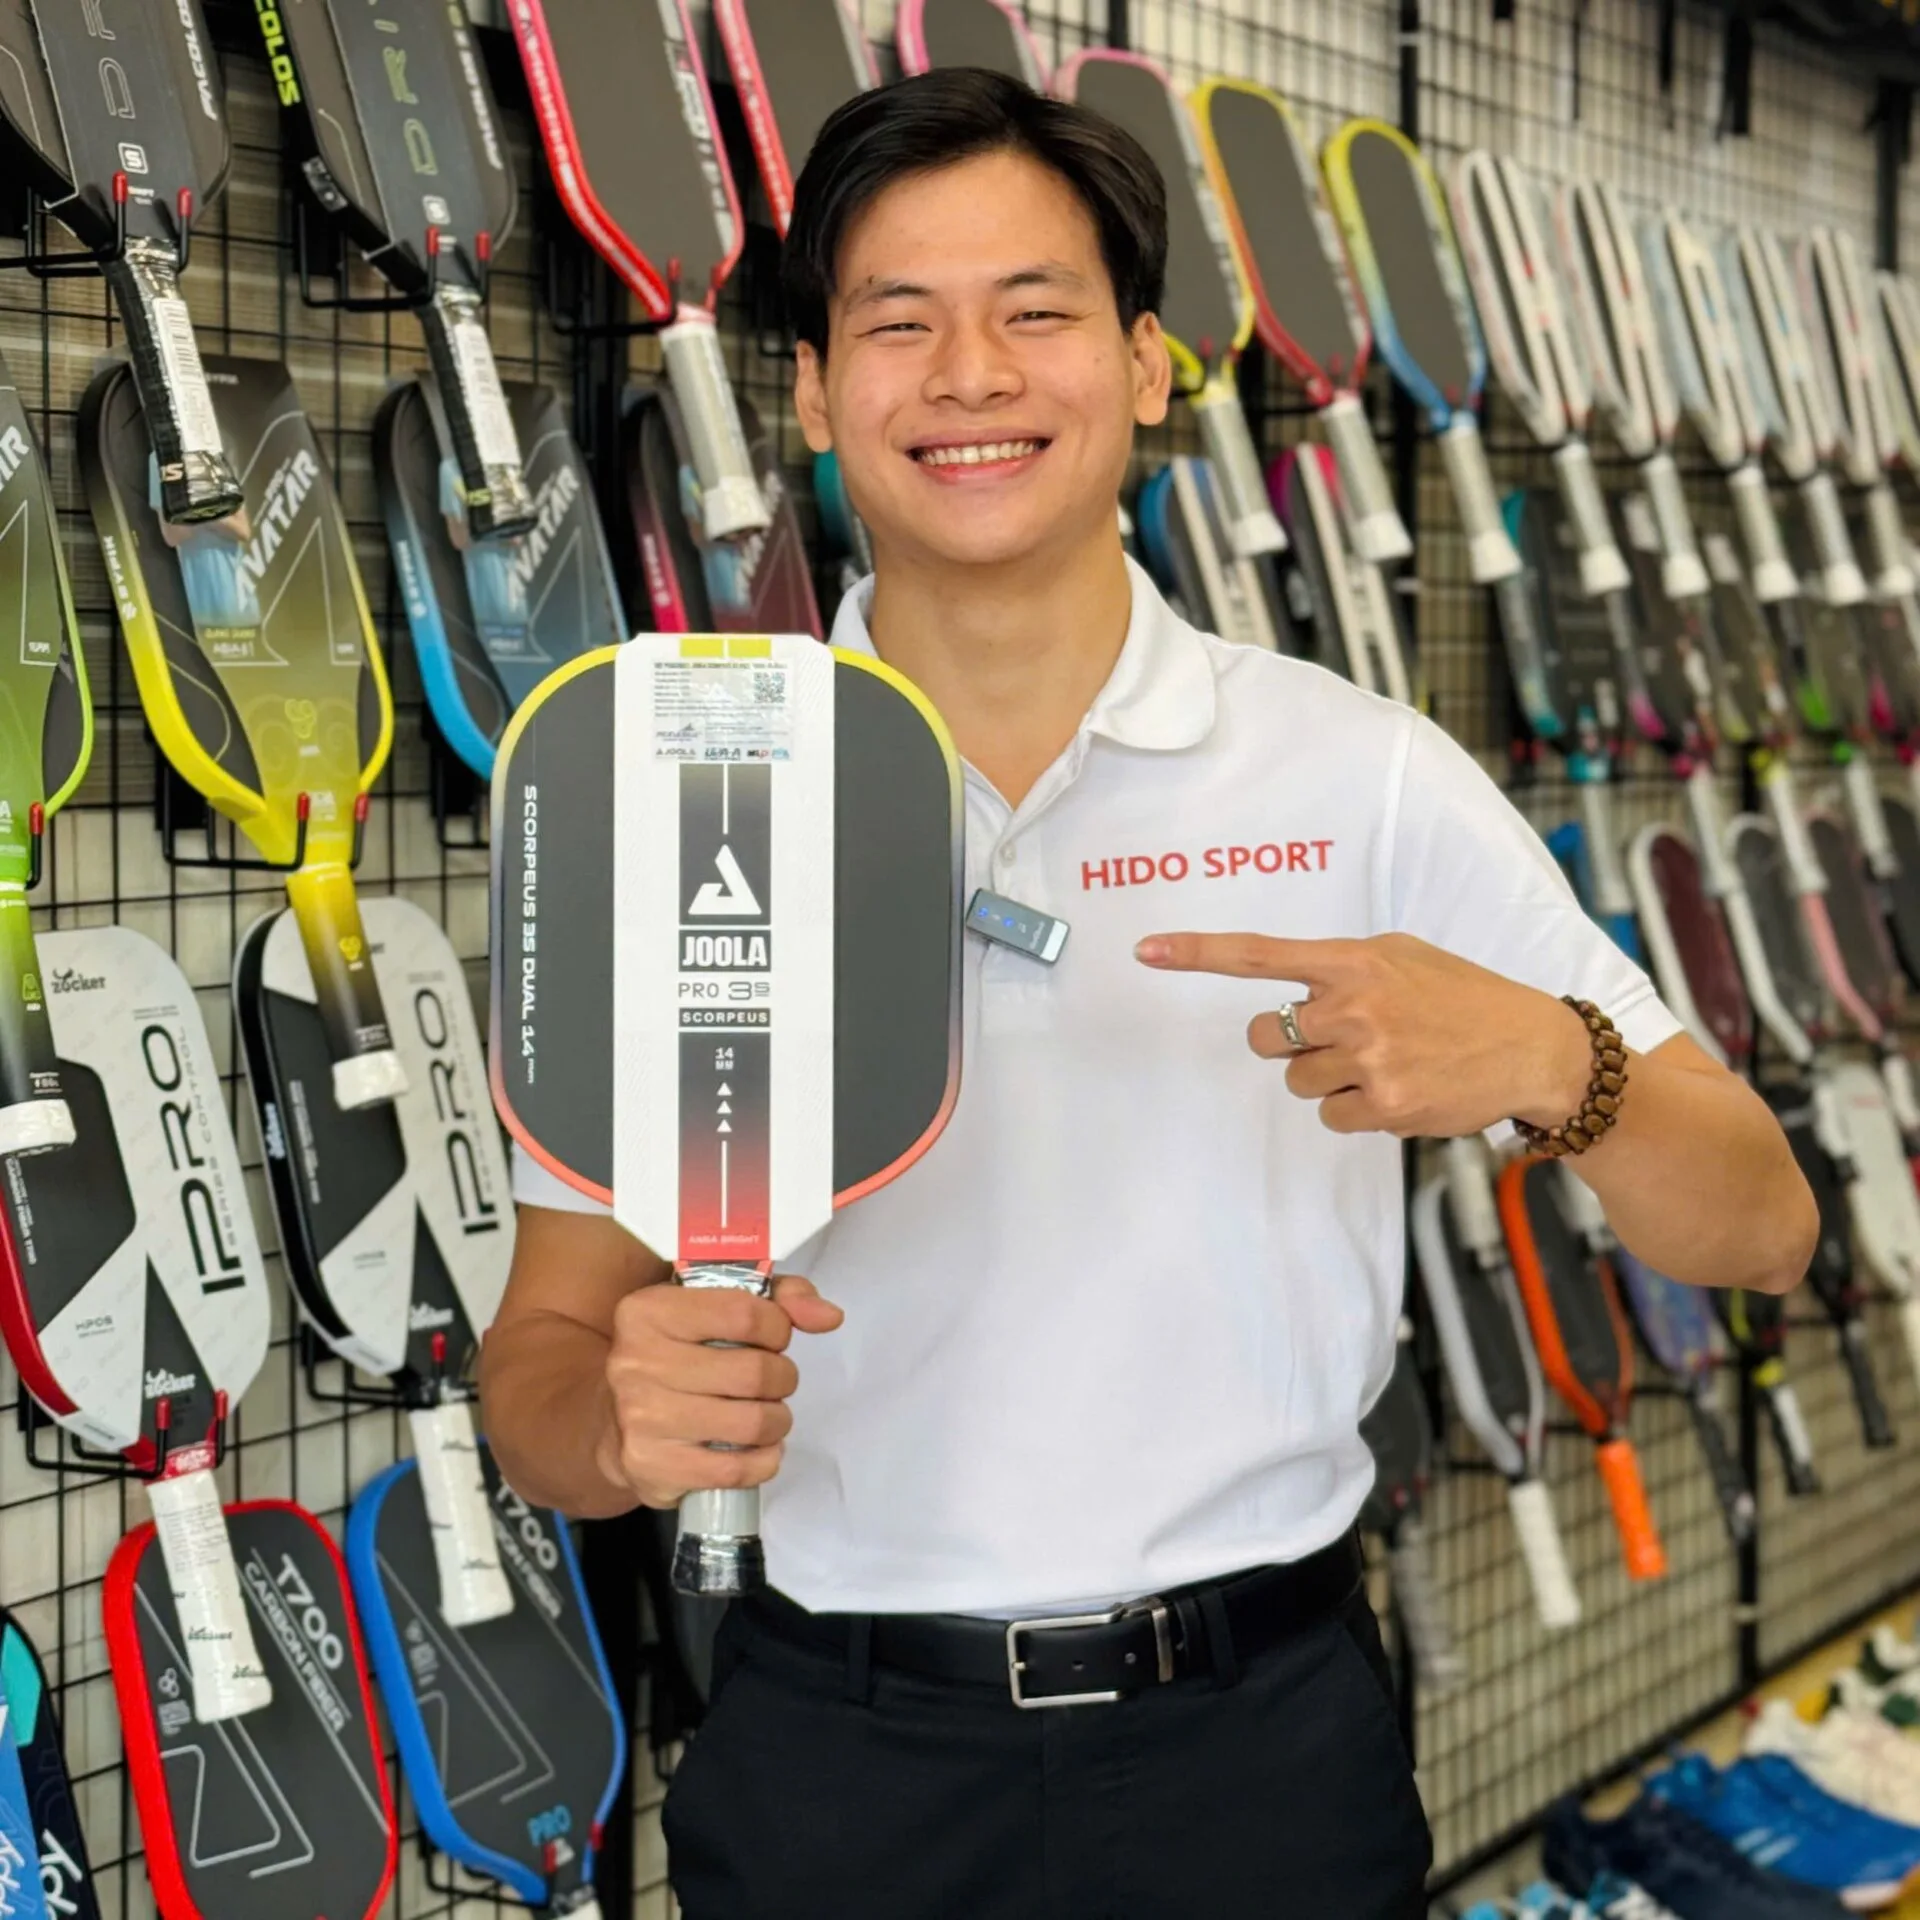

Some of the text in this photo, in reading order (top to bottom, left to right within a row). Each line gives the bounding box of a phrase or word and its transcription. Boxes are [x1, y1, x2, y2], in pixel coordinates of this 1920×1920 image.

[233, 449, 320, 613] AVATAR
[506, 464, 580, 613] AVATAR
[522, 785, 538, 917] SCORPEUS
[1080, 839, 1335, 891] HIDO SPORT
[522, 922, 537, 953] 3S
[681, 935, 768, 967] JOOLA
[521, 957, 536, 1020] DUAL
[678, 982, 720, 999] PRO
[681, 1011, 769, 1024] SCORPEUS
[715, 1047, 735, 1060] 14
[277, 1553, 344, 1669] T700
[244, 1561, 306, 1666] CARBON
[301, 1659, 346, 1733] FIBER
[527, 1803, 572, 1848] PRO
